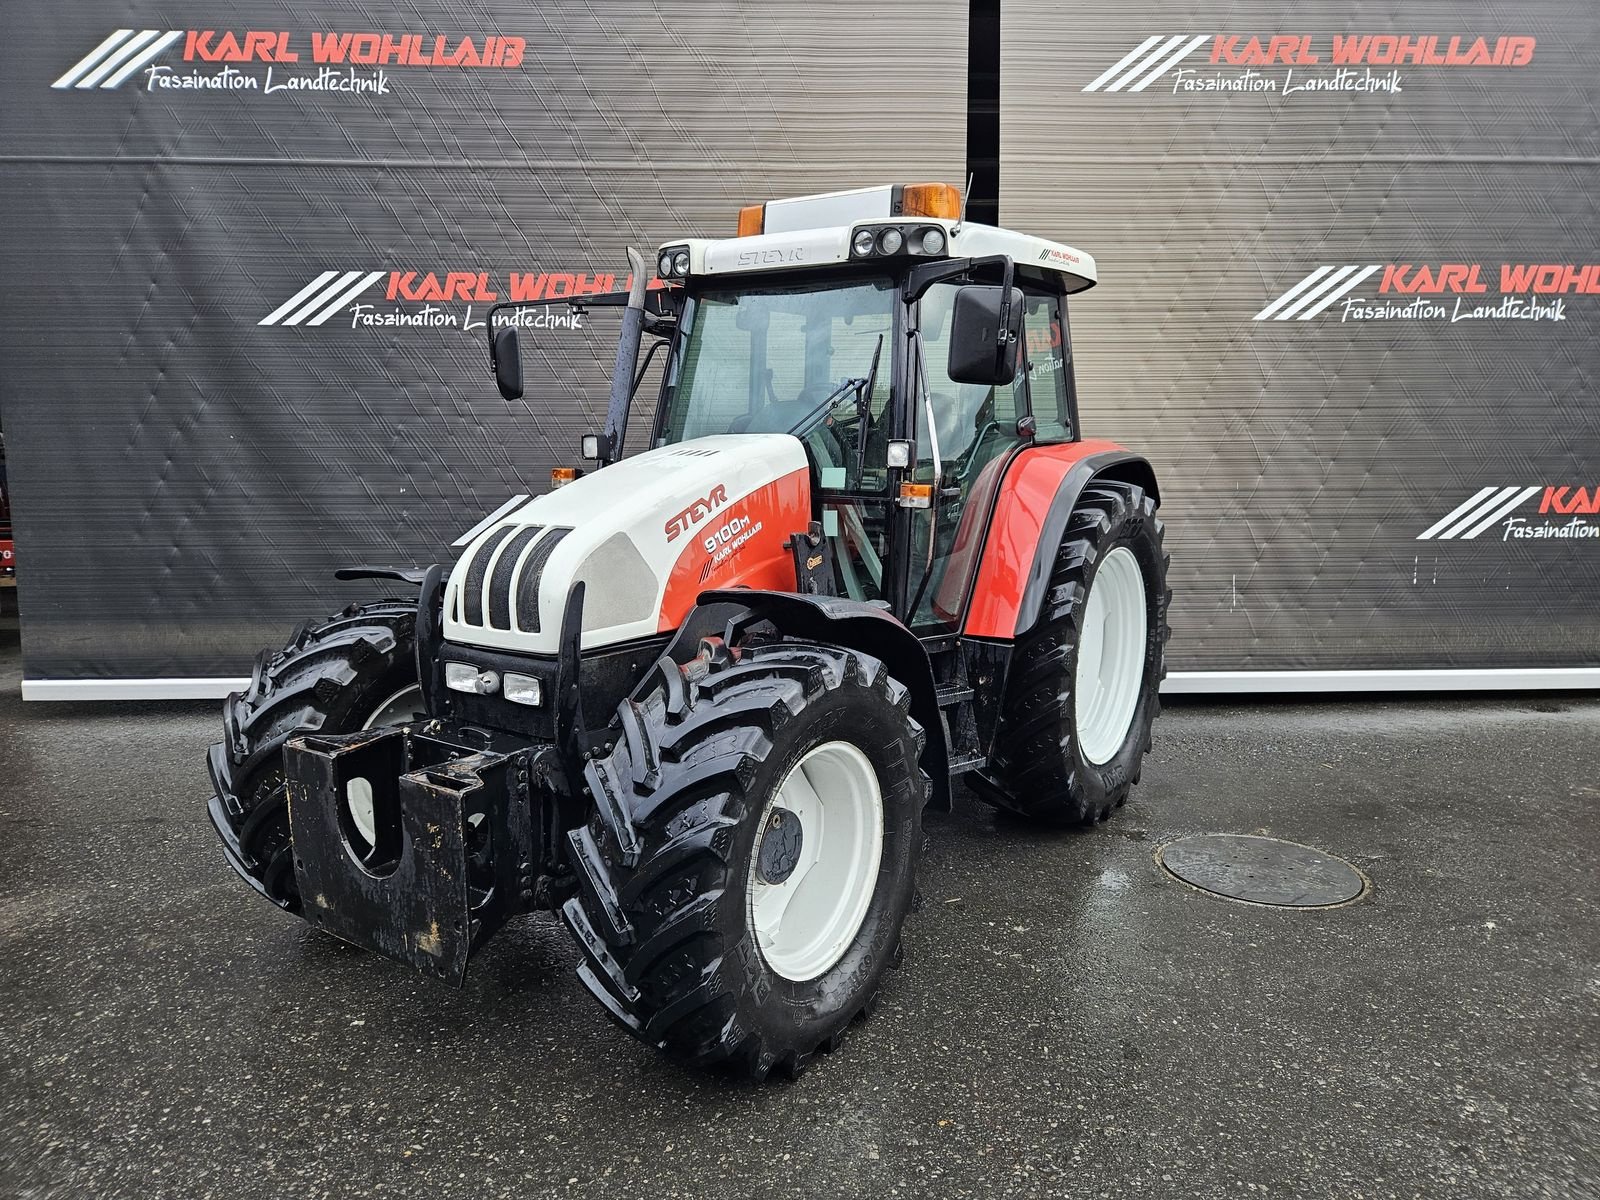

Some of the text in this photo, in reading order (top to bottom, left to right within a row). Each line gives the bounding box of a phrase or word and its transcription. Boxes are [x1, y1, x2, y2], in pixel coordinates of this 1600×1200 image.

[183, 30, 299, 62] KARL
[1209, 35, 1318, 65] KARL
[144, 65, 390, 95] Faszination Landtechnik
[1171, 68, 1402, 96] Faszination Landtechnik
[385, 271, 497, 301] KARL
[1378, 264, 1487, 294] KARL
[349, 303, 457, 329] Faszination
[1340, 296, 1566, 323] Faszination Landtechnik
[664, 483, 729, 543] STEYR
[1538, 486, 1600, 514] KA
[1502, 516, 1600, 542] Faszination
